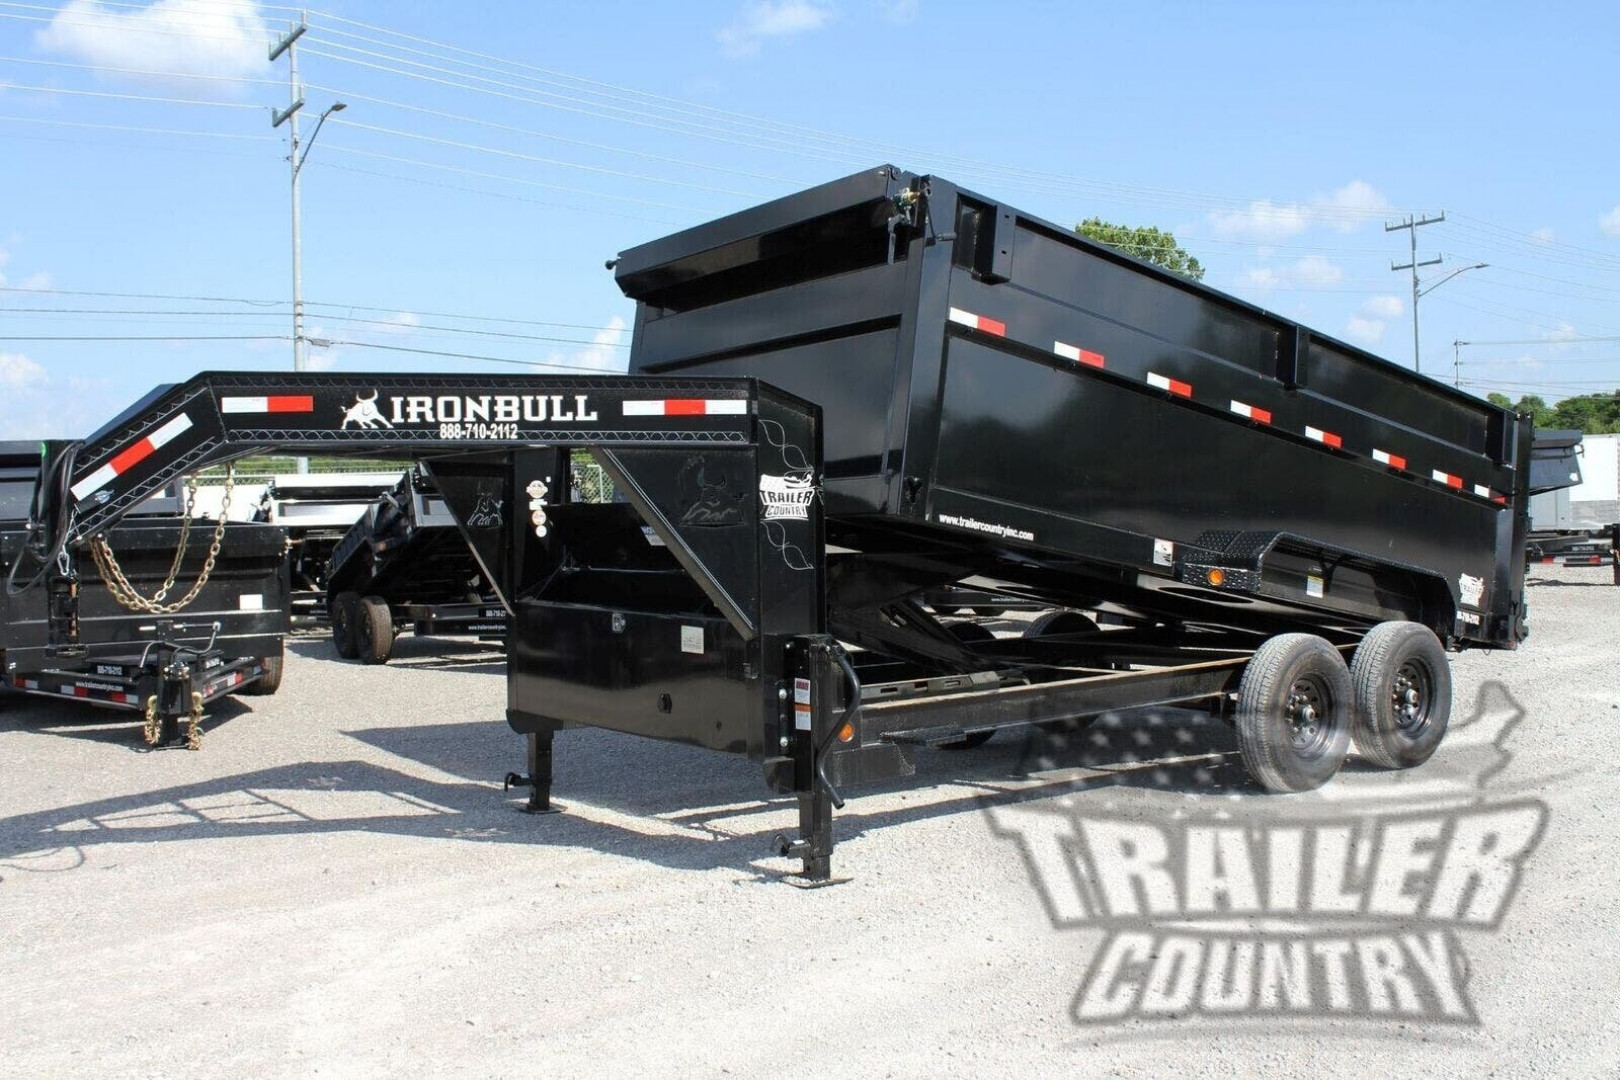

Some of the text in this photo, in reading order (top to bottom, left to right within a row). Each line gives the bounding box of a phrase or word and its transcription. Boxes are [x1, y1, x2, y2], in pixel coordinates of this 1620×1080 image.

[390, 395, 598, 423] IRONBULL
[439, 423, 518, 439] 888-710-2112
[760, 490, 814, 505] TRAILER
[767, 505, 807, 517] COUNTRY
[939, 514, 1034, 541] www.trailercountryinc.com
